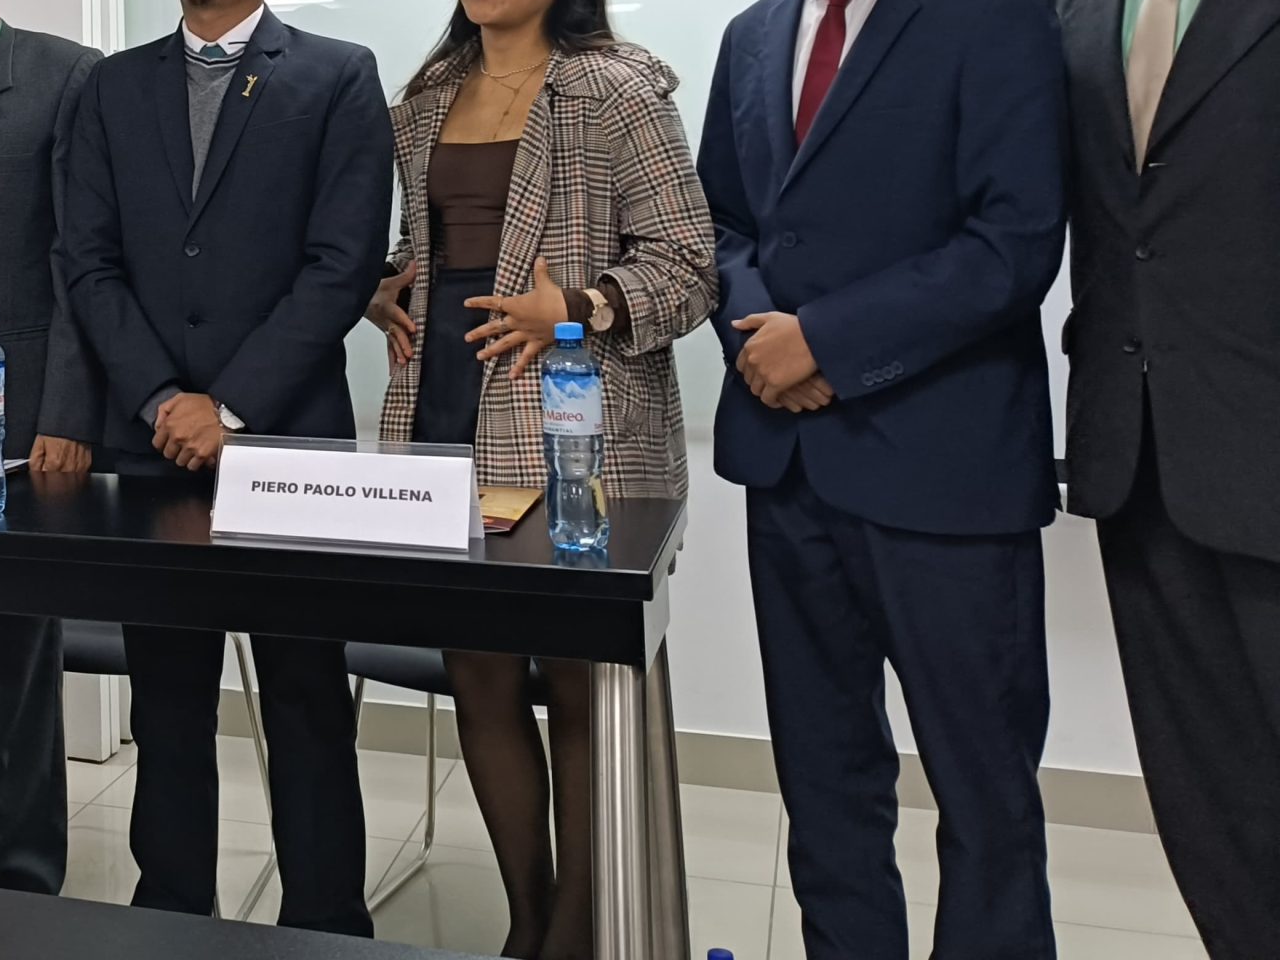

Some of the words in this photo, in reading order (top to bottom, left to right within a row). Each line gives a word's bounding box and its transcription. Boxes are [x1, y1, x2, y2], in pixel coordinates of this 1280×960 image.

[546, 410, 585, 423] Mateo
[251, 481, 299, 494] PIERO
[303, 484, 357, 498] PAOLO
[362, 487, 433, 503] VILLENA
